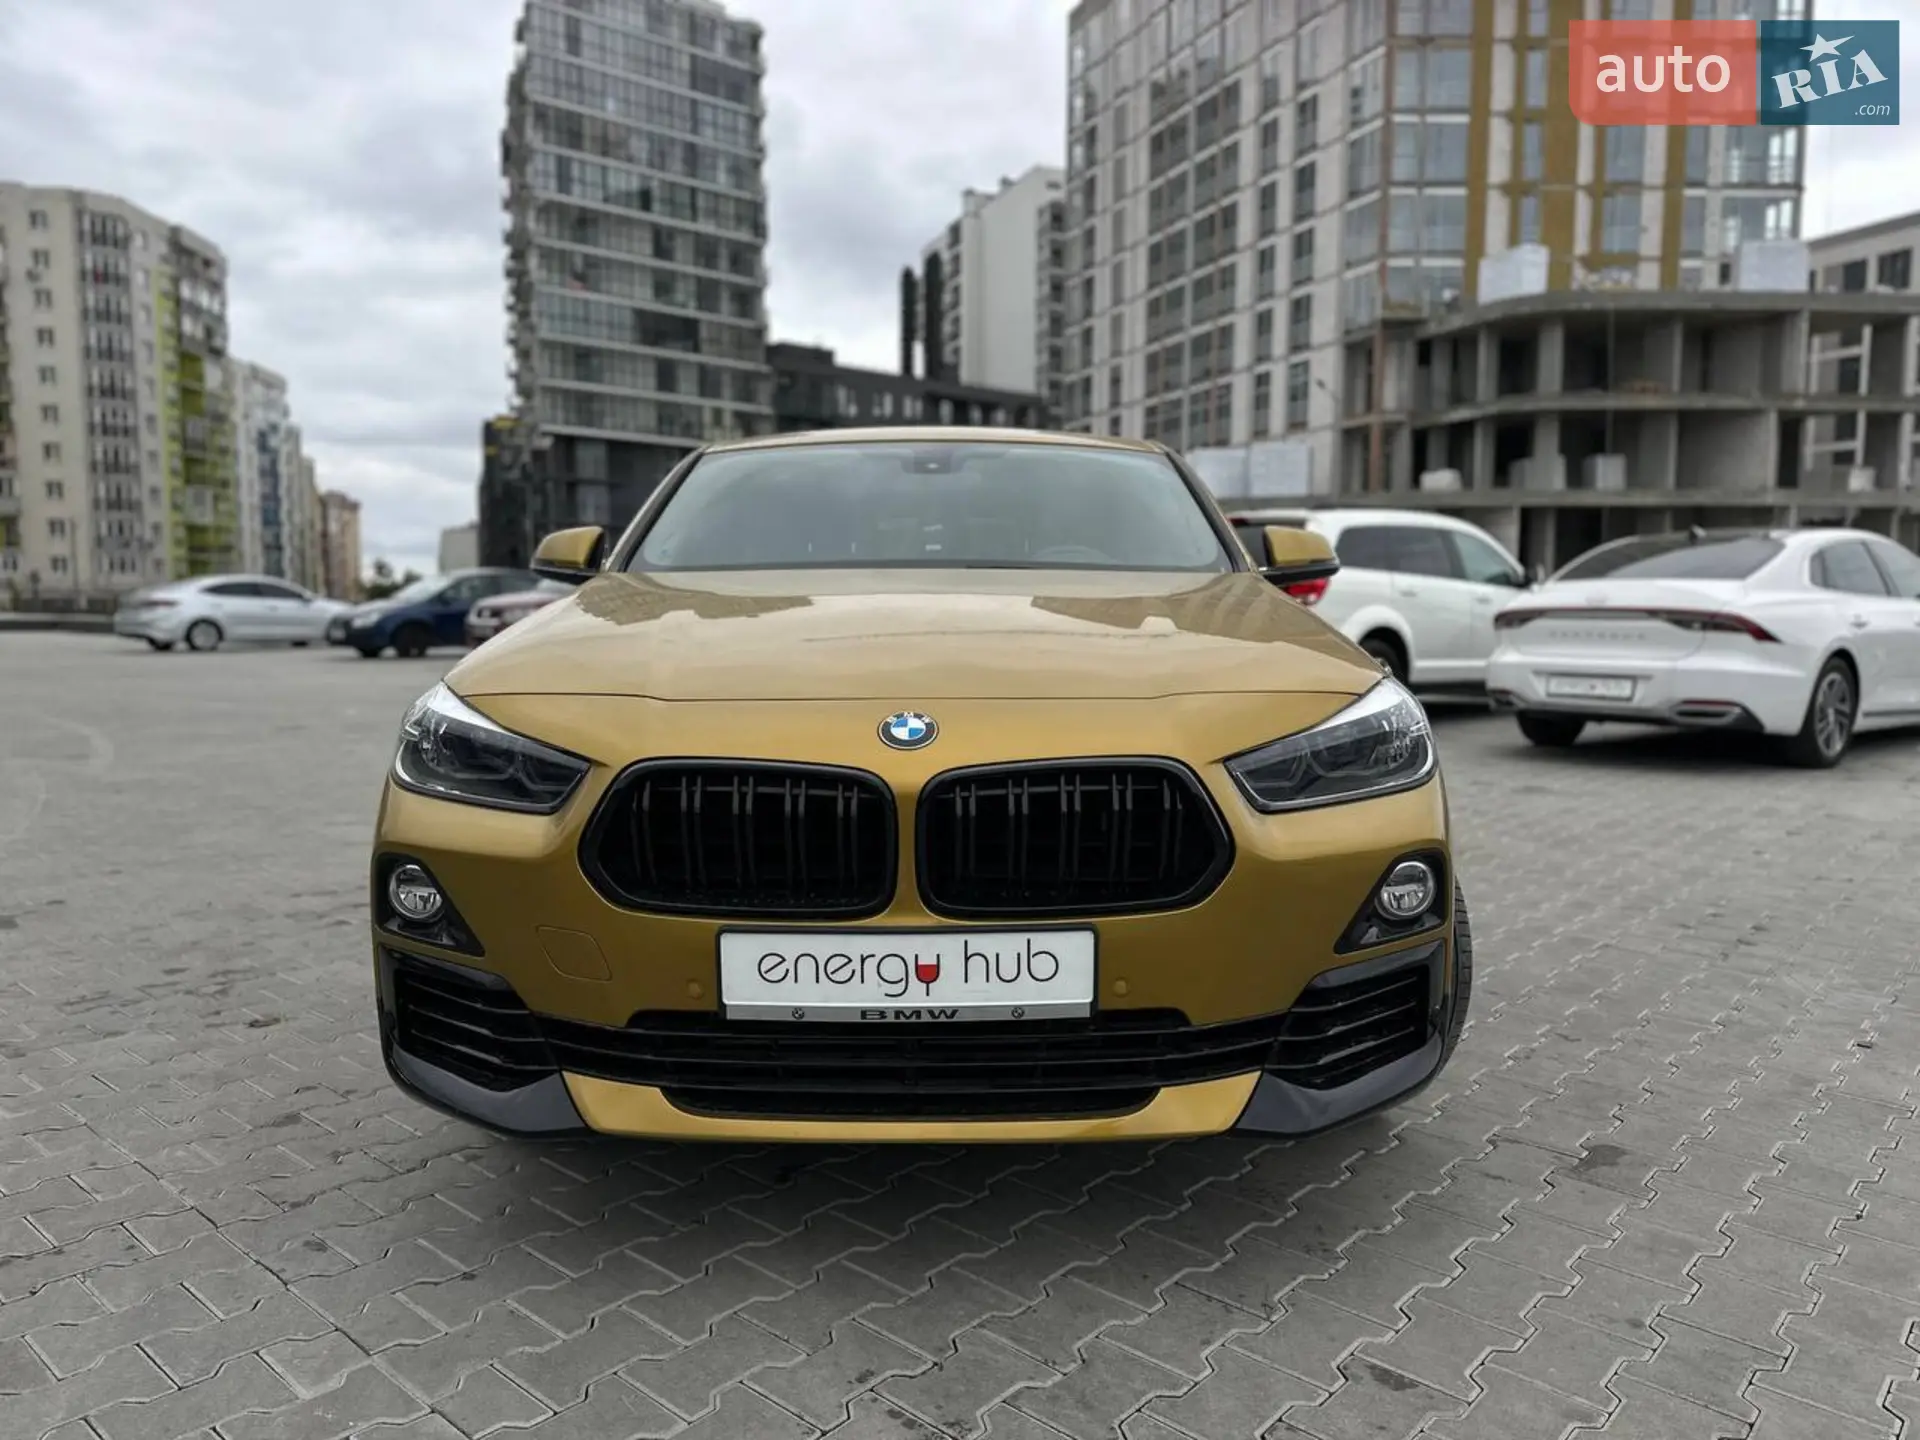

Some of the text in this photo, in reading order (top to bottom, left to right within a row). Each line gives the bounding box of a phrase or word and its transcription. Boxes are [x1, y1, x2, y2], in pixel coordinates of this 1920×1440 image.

[757, 938, 1060, 997] energy hub
[860, 1010, 960, 1020] BMW
